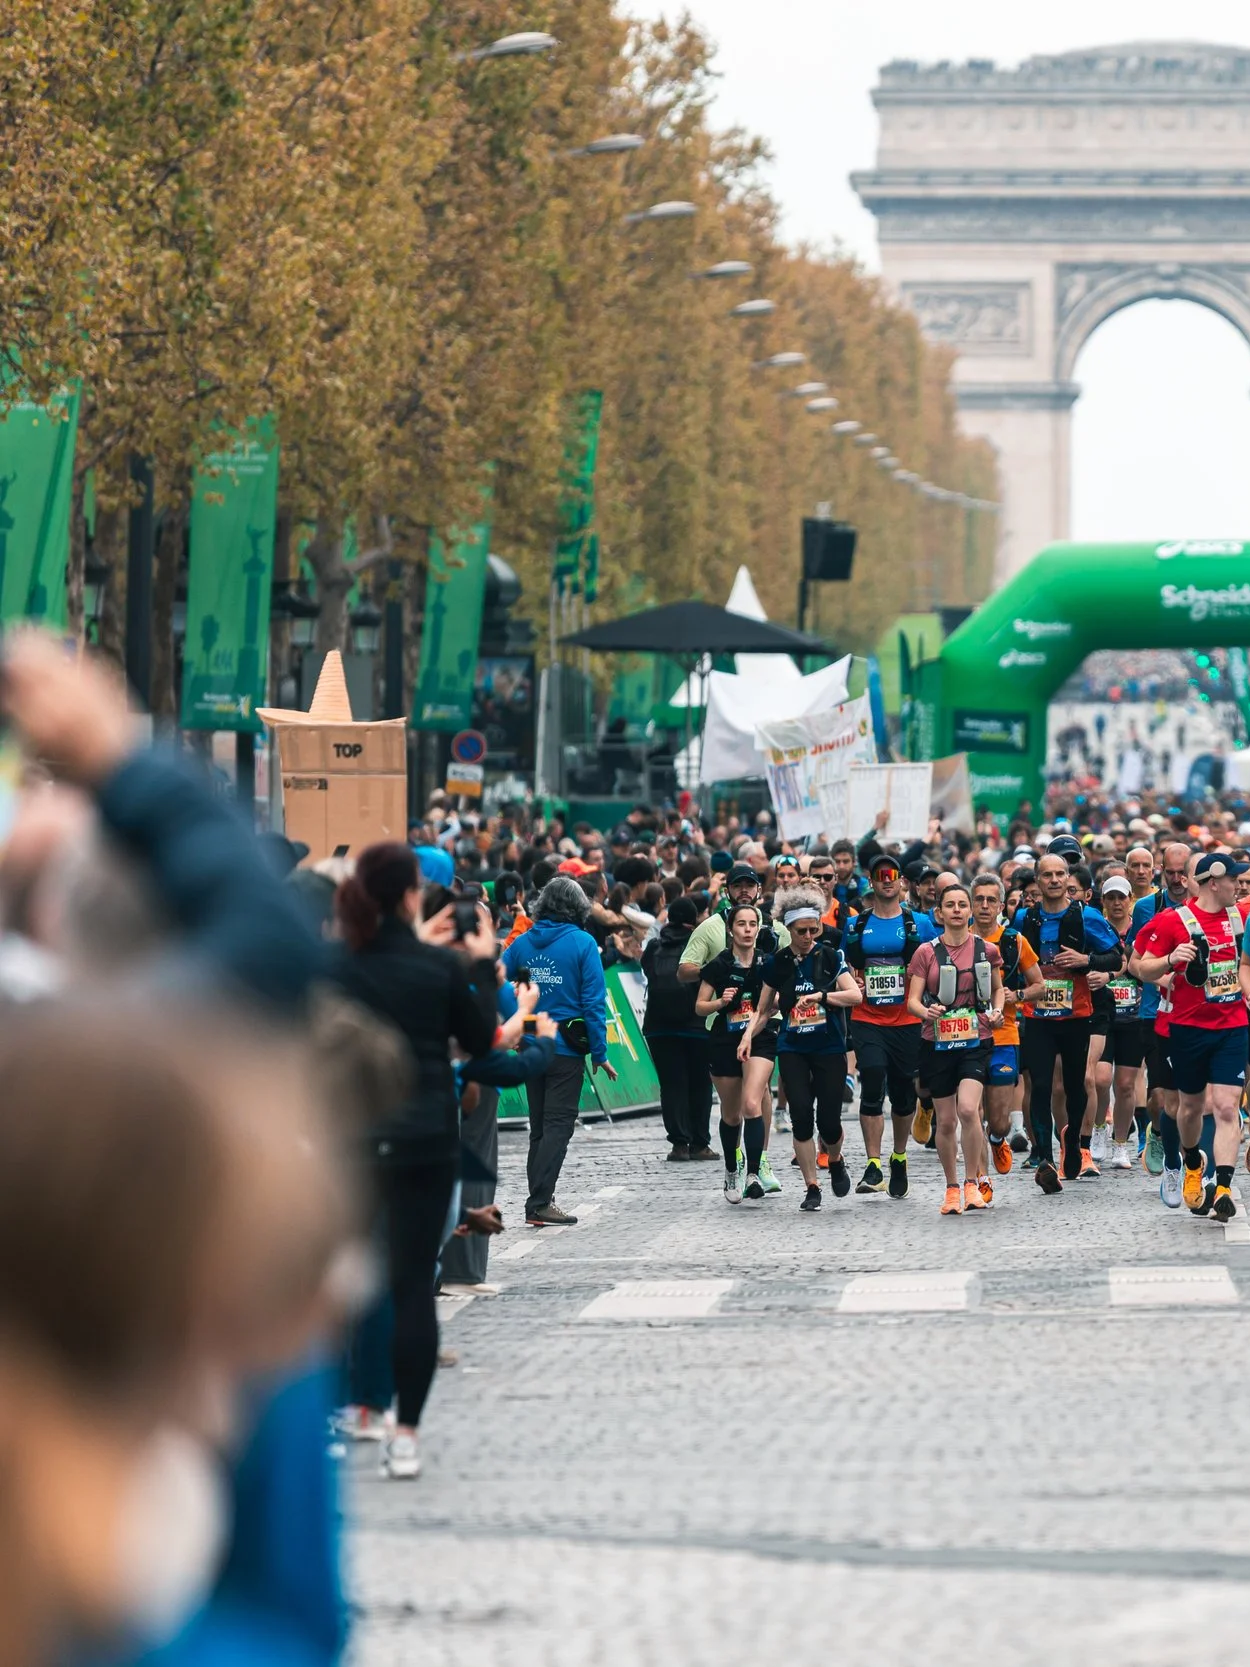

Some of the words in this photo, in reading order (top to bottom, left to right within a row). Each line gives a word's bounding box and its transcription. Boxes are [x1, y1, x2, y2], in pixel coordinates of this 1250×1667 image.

[333, 743, 363, 758] TOP
[869, 976, 896, 990] 31859
[939, 1018, 969, 1033] 65796
